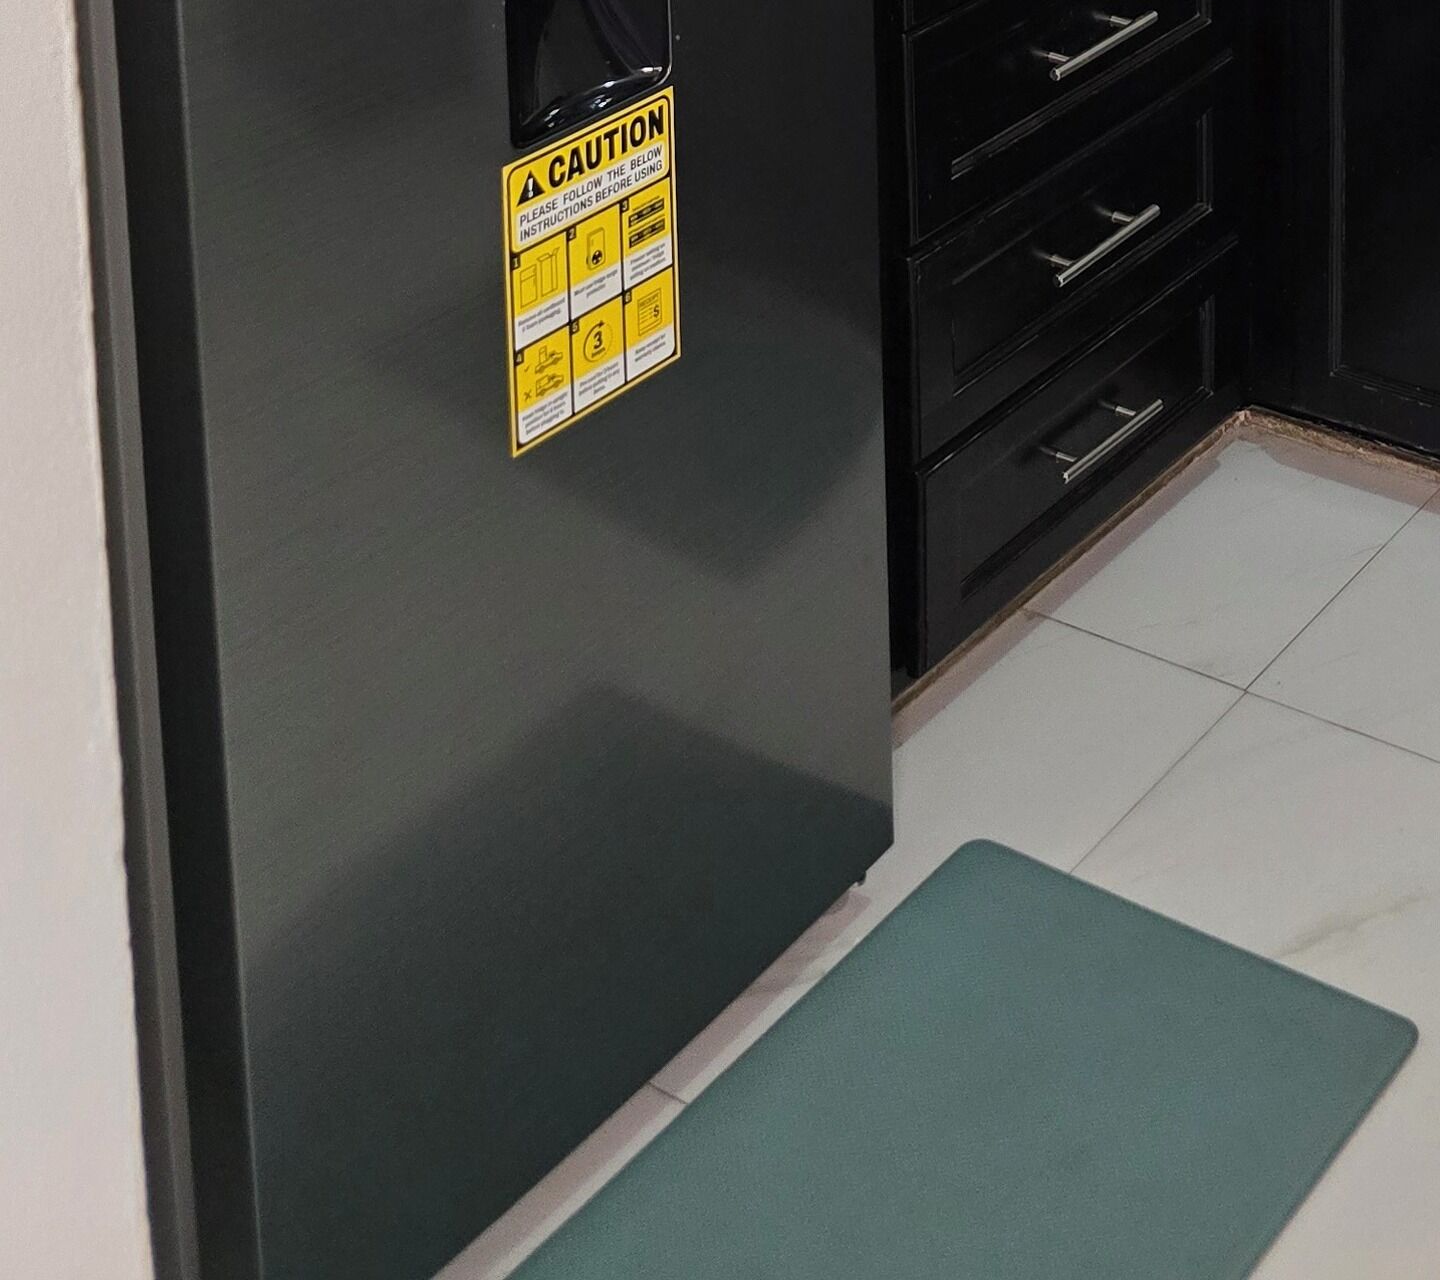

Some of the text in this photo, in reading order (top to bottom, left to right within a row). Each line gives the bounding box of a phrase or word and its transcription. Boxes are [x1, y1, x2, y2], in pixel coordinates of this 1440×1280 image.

[520, 199, 558, 227] PLEASE
[563, 175, 603, 205] FOLLOW
[607, 166, 626, 182] THE
[630, 145, 663, 171] BELOW
[548, 104, 664, 189] CAUTION
[520, 194, 594, 242] INSTRUCTIONS
[595, 175, 632, 203] BEFORE
[635, 159, 663, 182] USING
[569, 229, 576, 239] 2
[593, 330, 603, 350] 3
